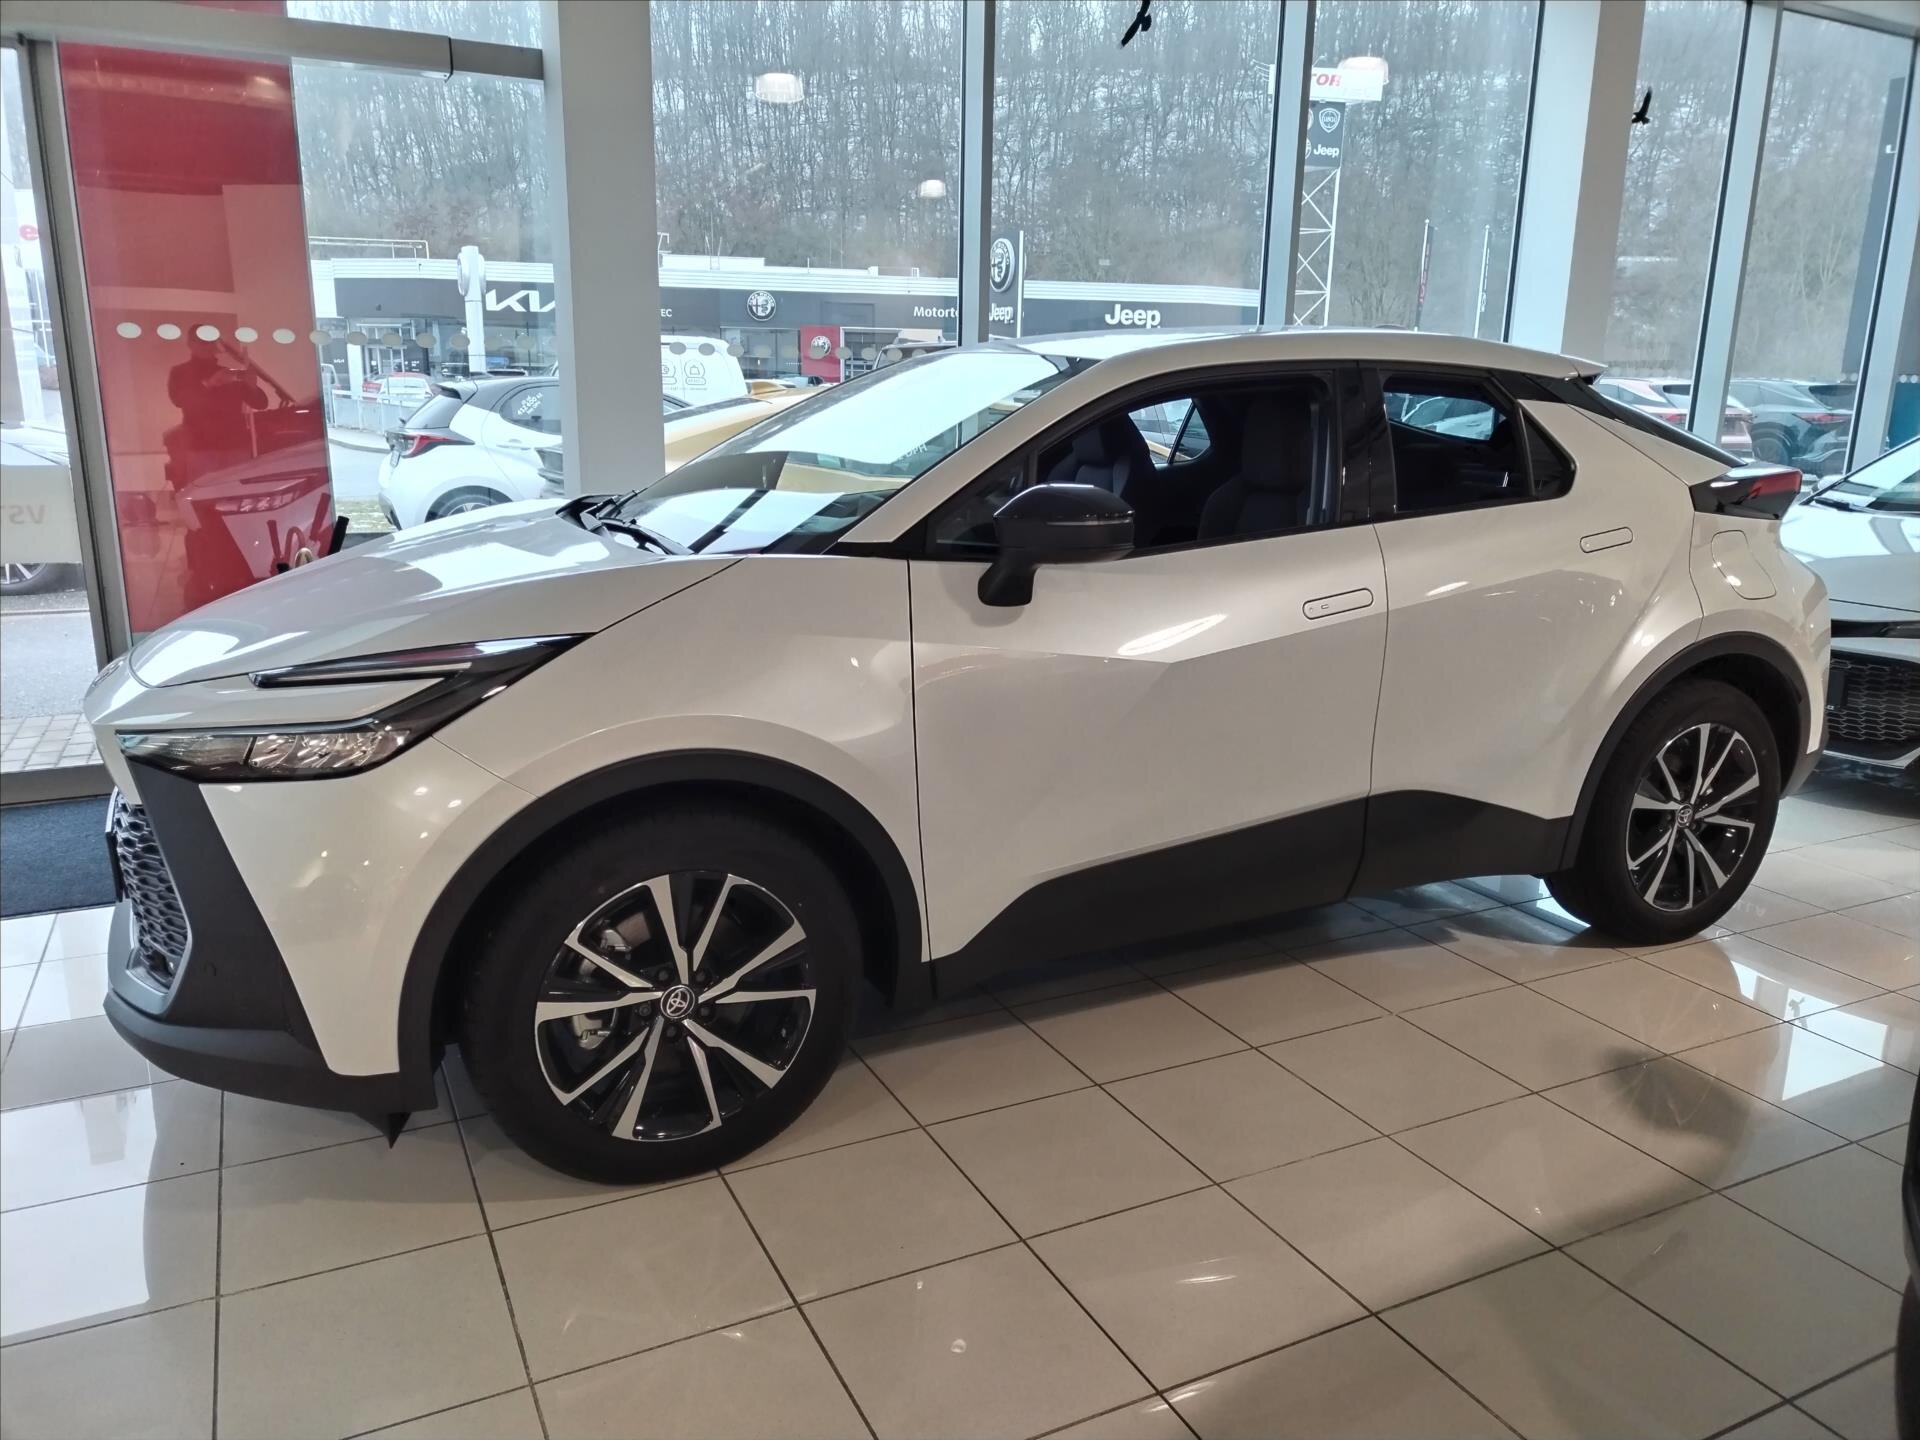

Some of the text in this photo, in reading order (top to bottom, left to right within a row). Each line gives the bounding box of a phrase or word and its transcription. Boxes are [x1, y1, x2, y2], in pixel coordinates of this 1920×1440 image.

[1313, 144, 1340, 159] Jeep
[988, 302, 1014, 325] Jeep
[1104, 303, 1161, 329] Jeep
